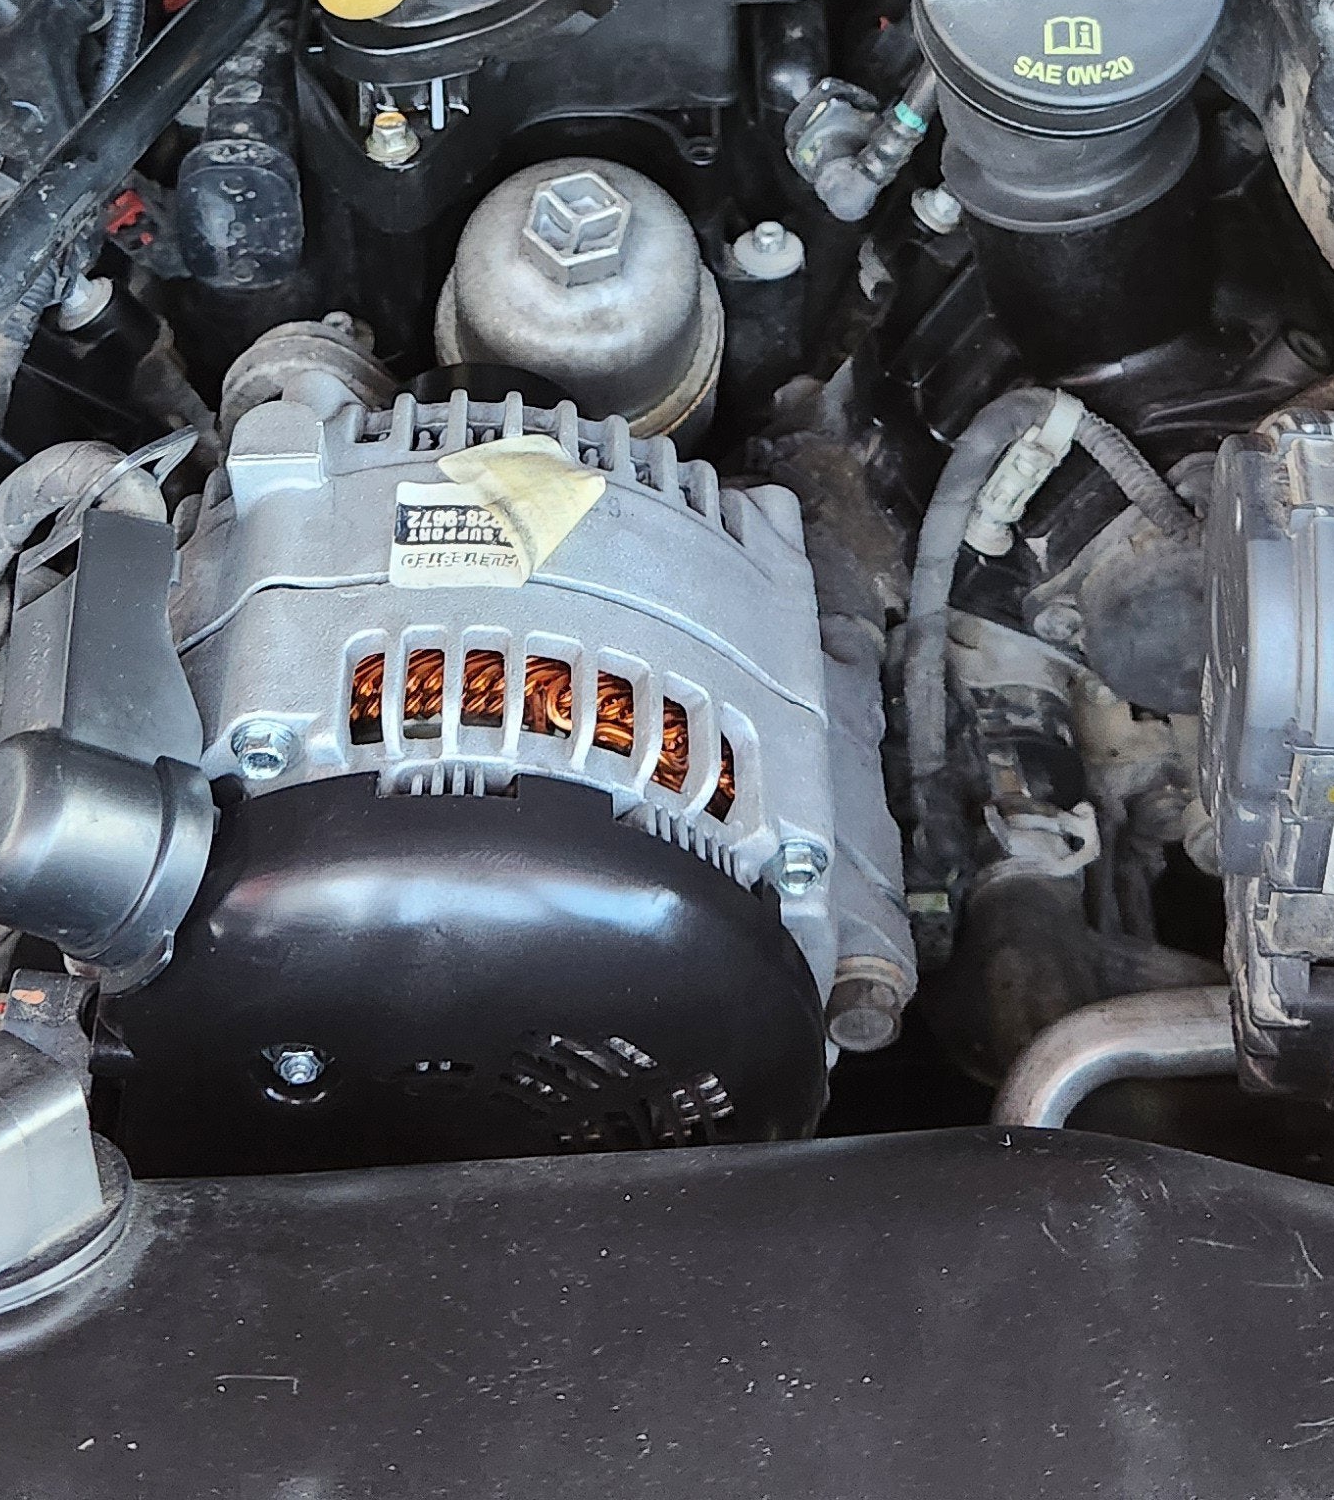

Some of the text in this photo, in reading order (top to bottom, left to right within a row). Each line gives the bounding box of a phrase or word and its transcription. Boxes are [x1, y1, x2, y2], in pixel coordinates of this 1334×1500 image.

[1013, 55, 1134, 86] SAE 0W-20
[407, 527, 494, 543] SUPPORT
